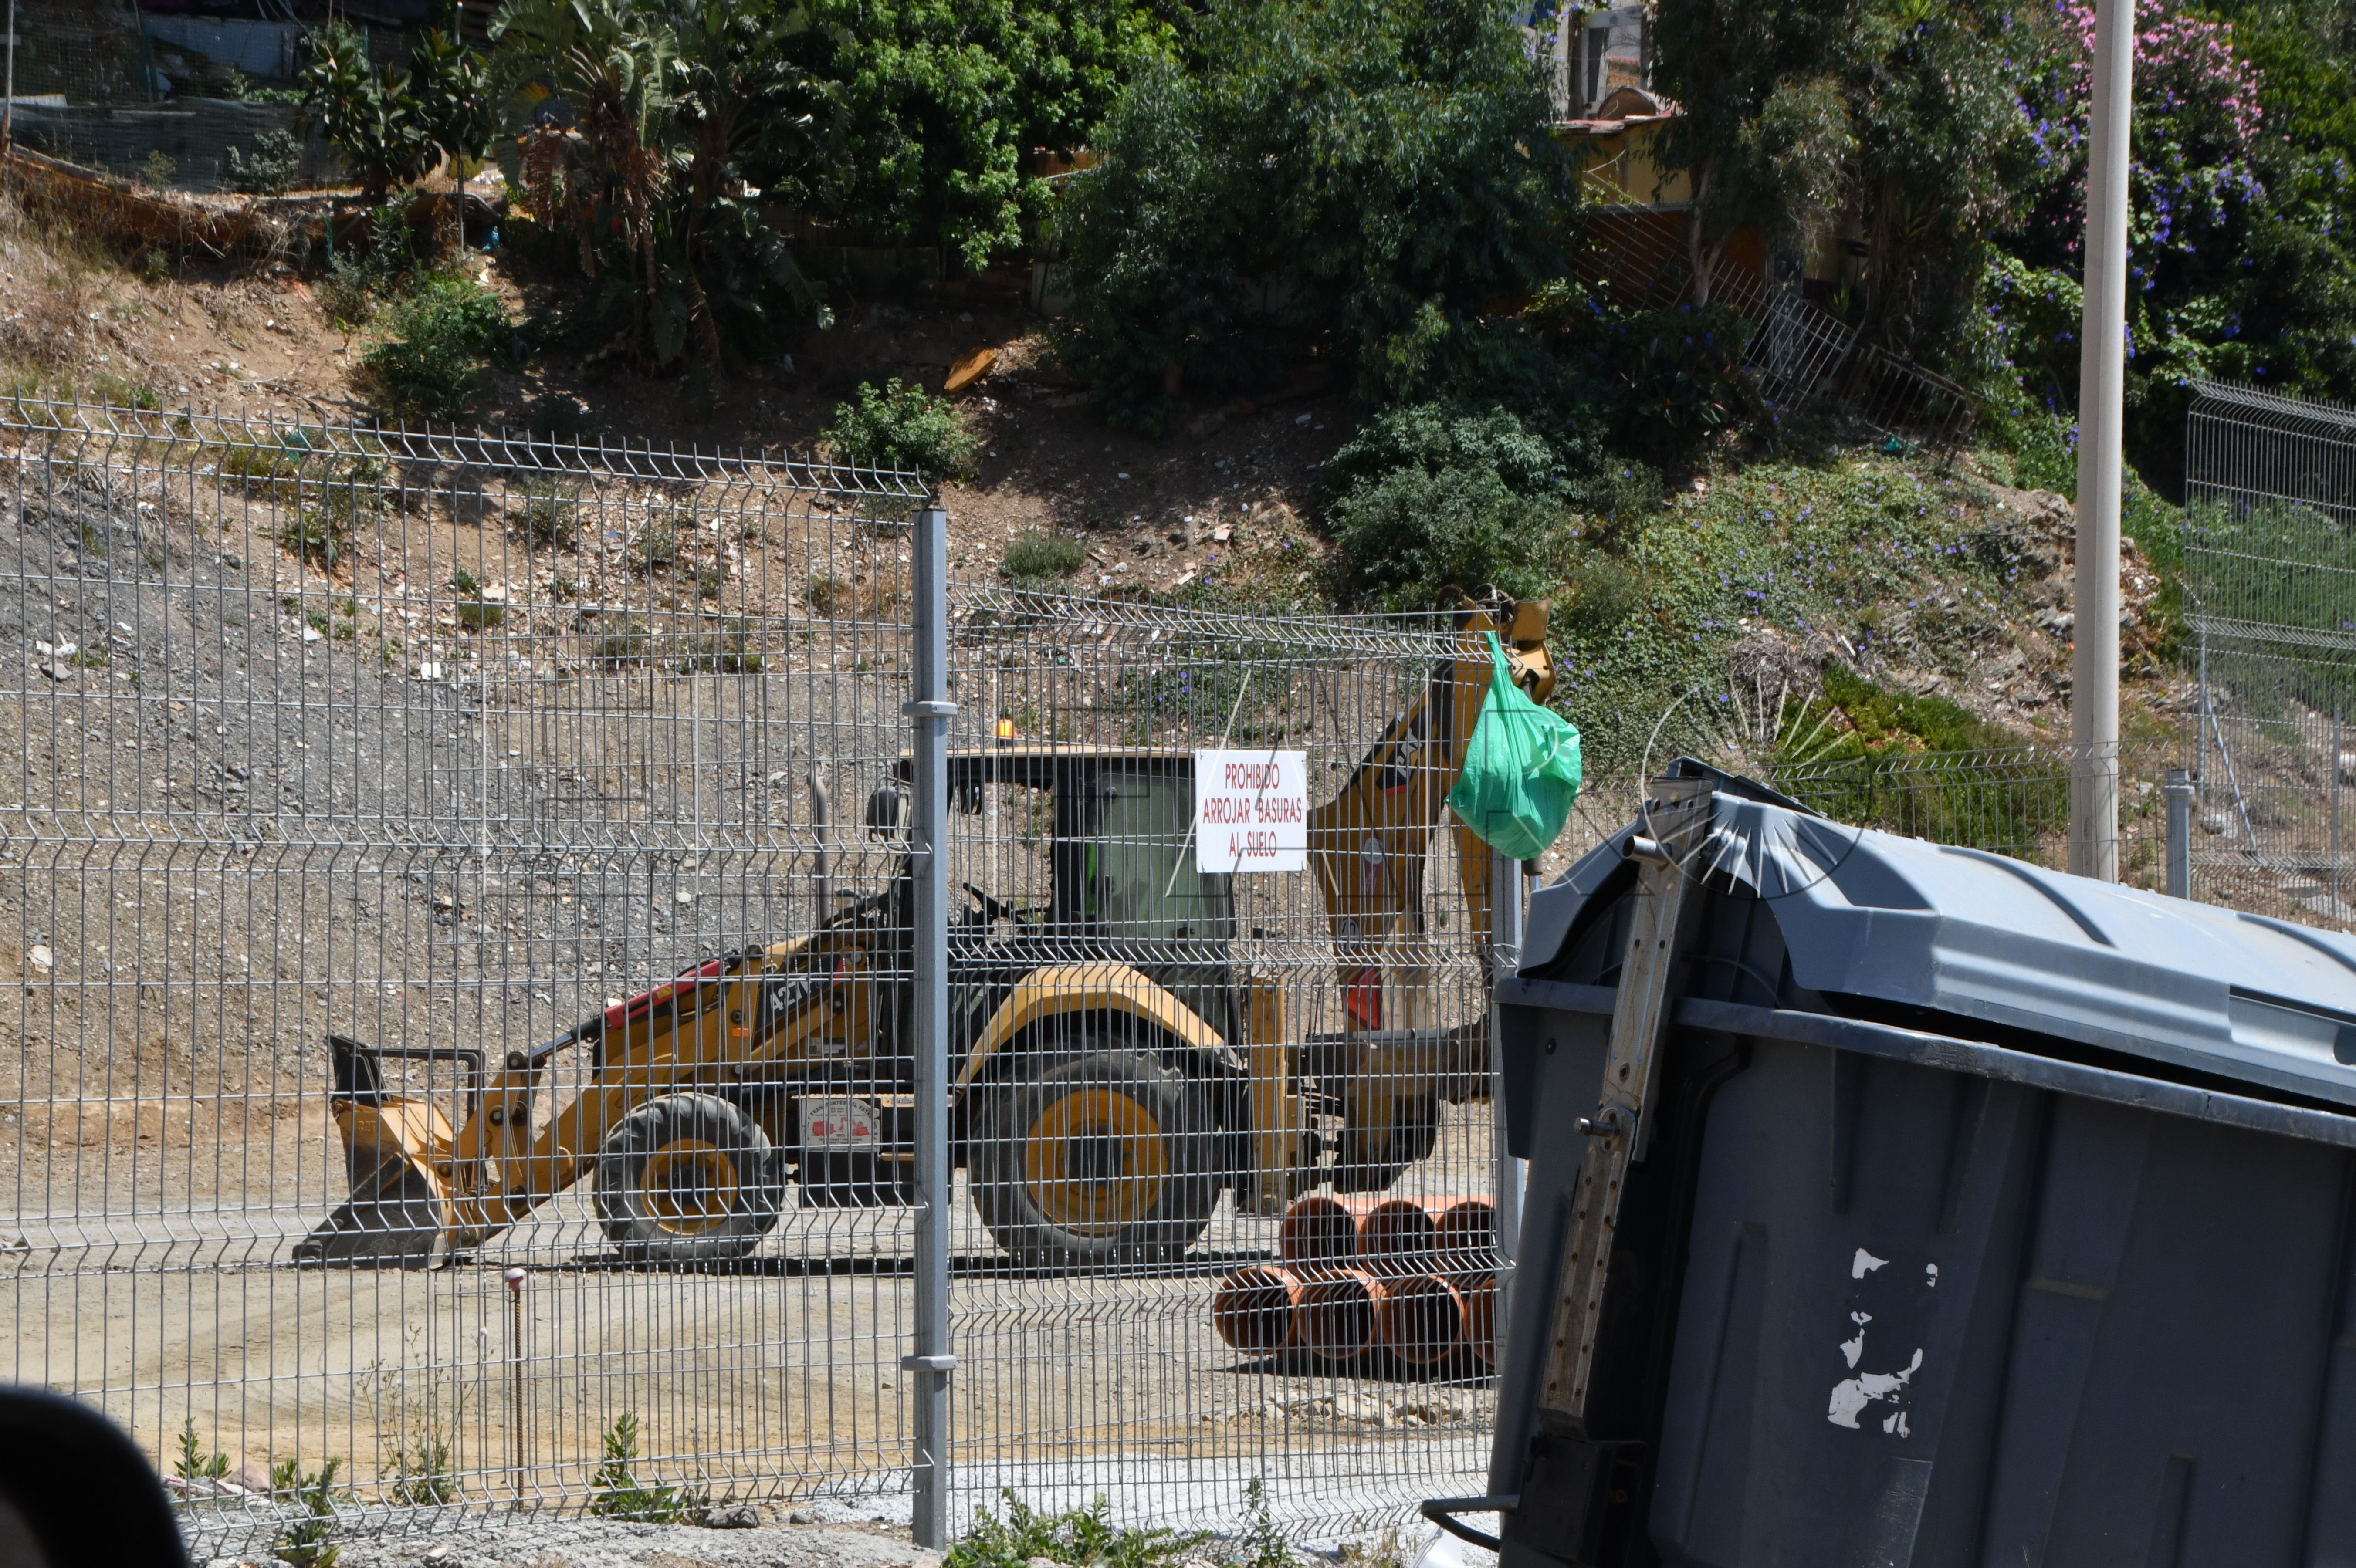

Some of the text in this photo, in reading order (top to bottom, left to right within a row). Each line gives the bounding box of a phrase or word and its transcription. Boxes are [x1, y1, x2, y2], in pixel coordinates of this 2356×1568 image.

[1225, 763, 1280, 789] PROHIBIDO
[1203, 797, 1302, 824] ARROJAR BASURAS
[1229, 831, 1277, 857] AL SUELO
